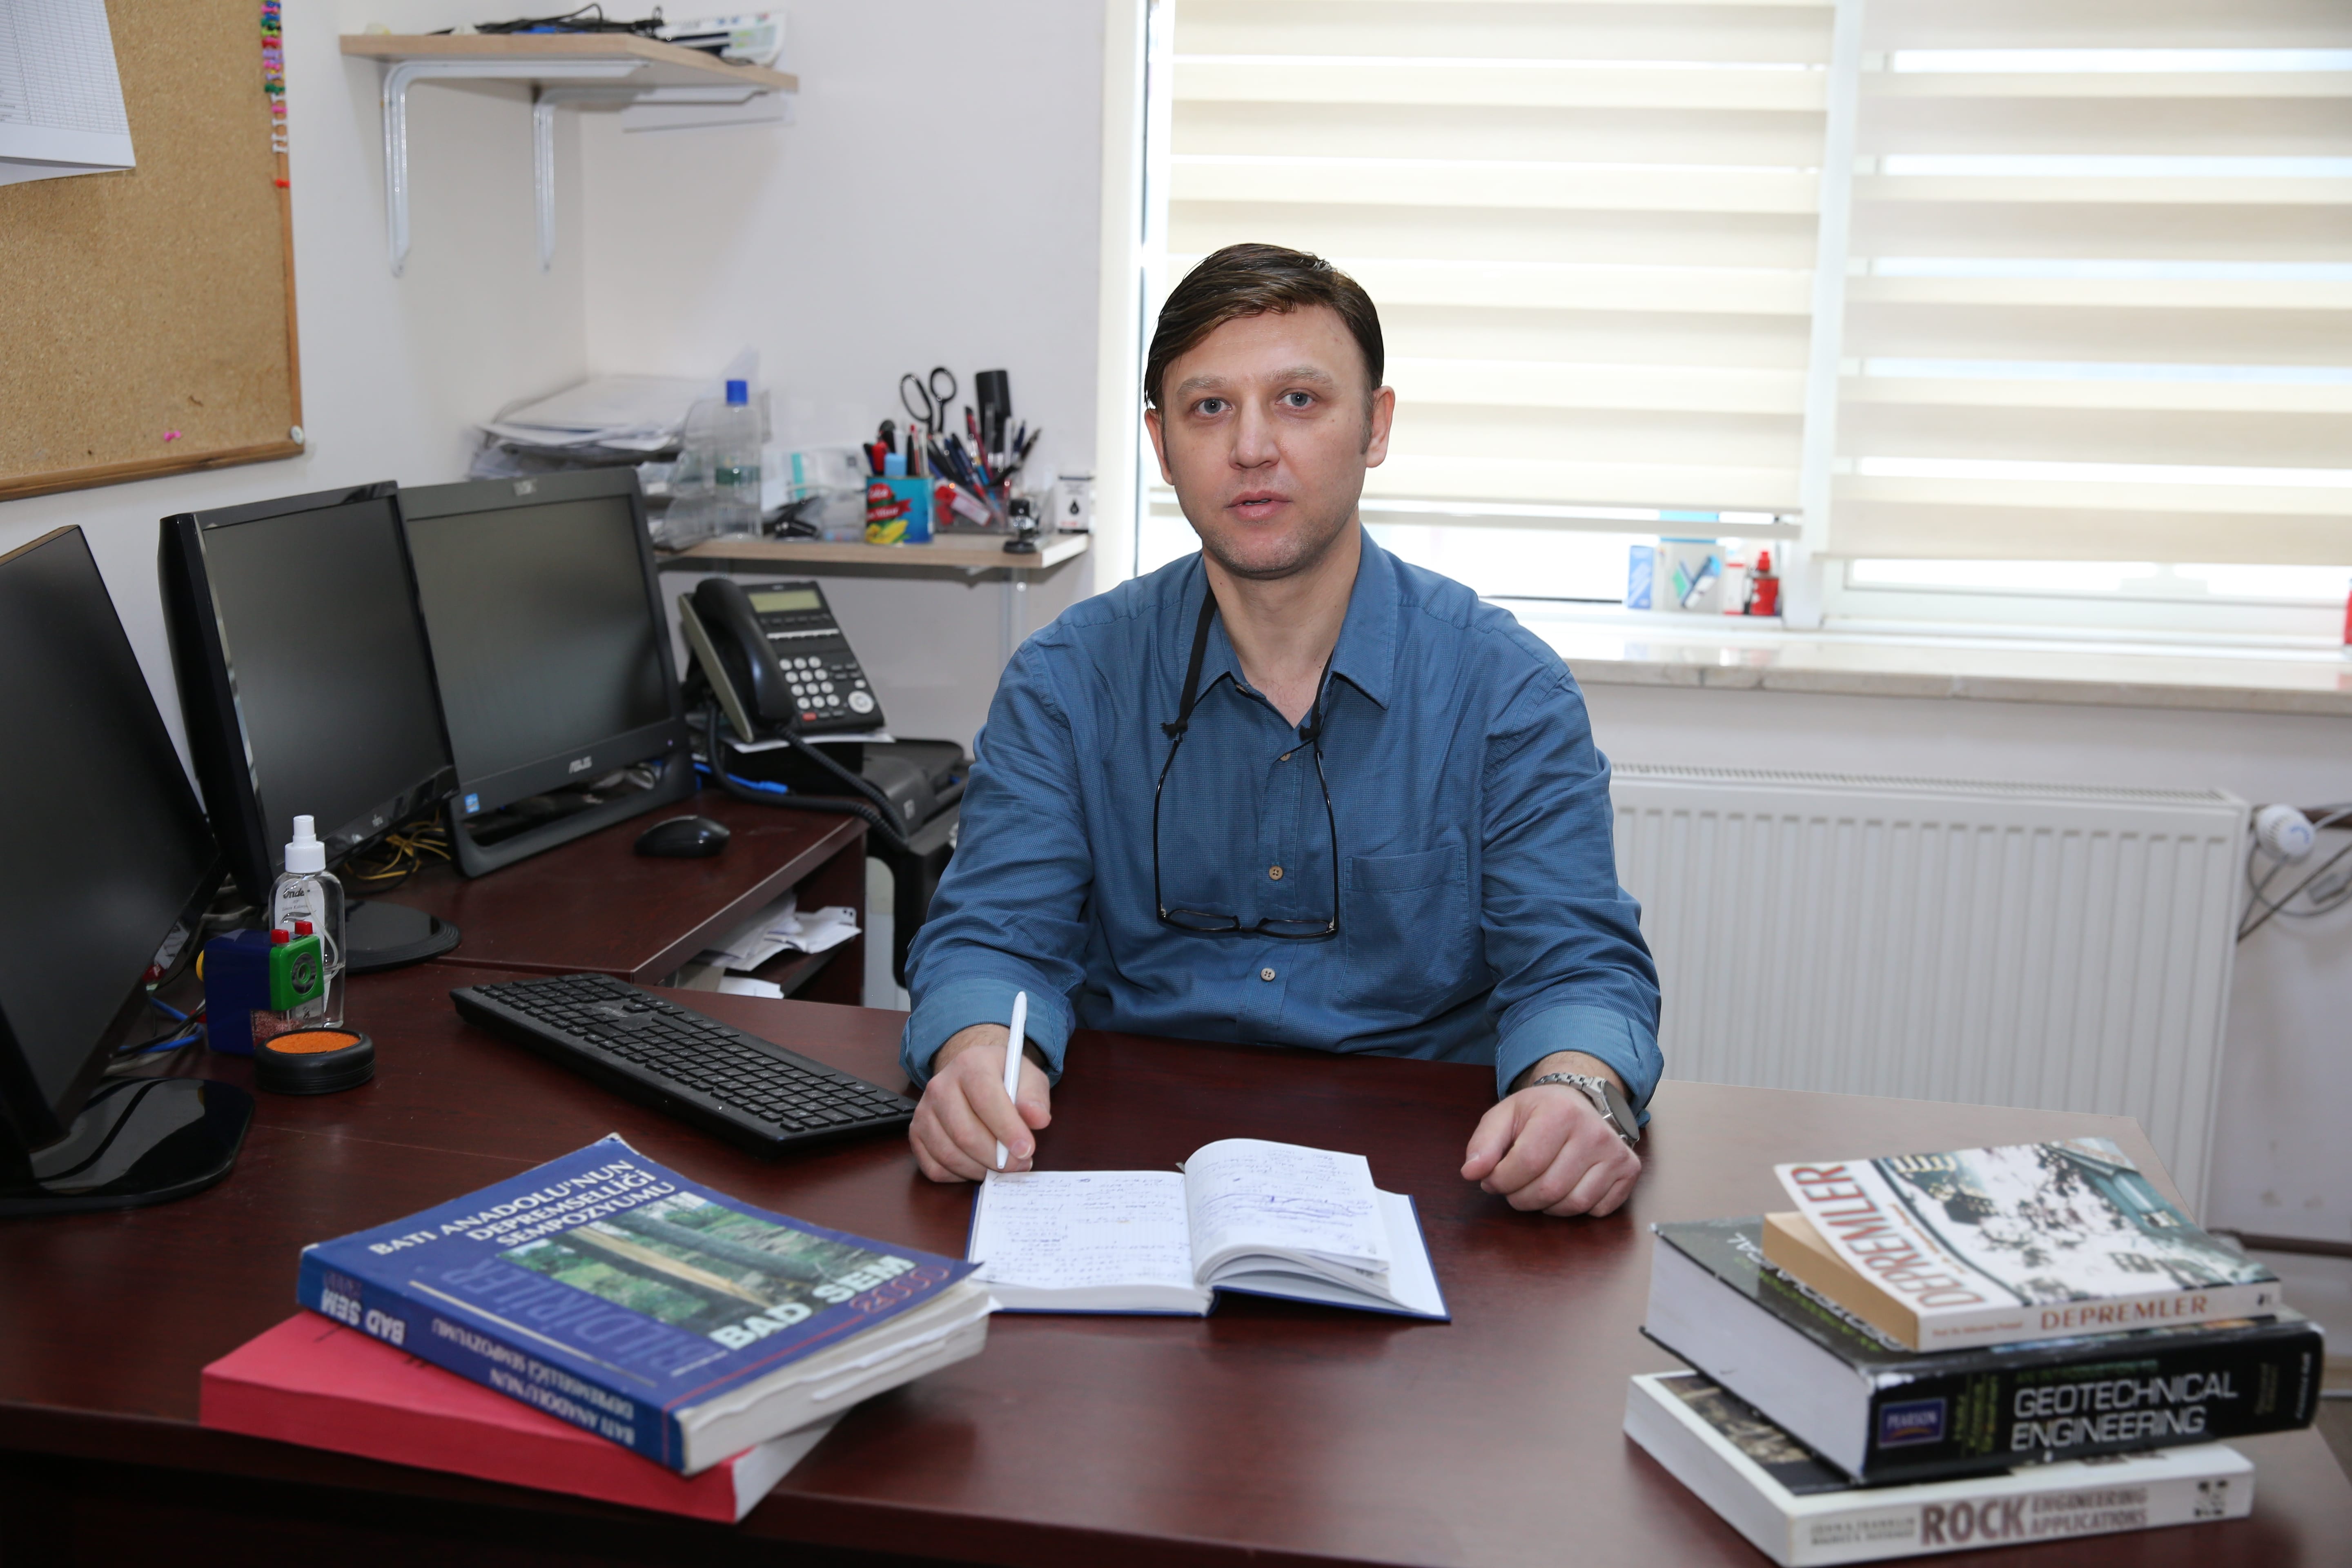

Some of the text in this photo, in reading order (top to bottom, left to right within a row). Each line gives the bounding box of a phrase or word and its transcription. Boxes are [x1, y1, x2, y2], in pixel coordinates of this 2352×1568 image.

[368, 1160, 636, 1256] BATI ANADOLU'NUN
[465, 1168, 658, 1242] DEPREMSELLİĞİ
[496, 1180, 677, 1247] SEMPOZYUMU
[1791, 1165, 1985, 1307] DEPREMLER
[321, 1287, 406, 1346] BAD SEM
[708, 1255, 916, 1350] BAD SEM
[2041, 1296, 2209, 1330] DEPREMLER
[2013, 1370, 2239, 1419] GEOTECHNICAL
[2010, 1405, 2206, 1452] ENGINEERING
[1921, 1496, 2027, 1546] ROCK
[2031, 1507, 2148, 1536] APPLICATIONS
